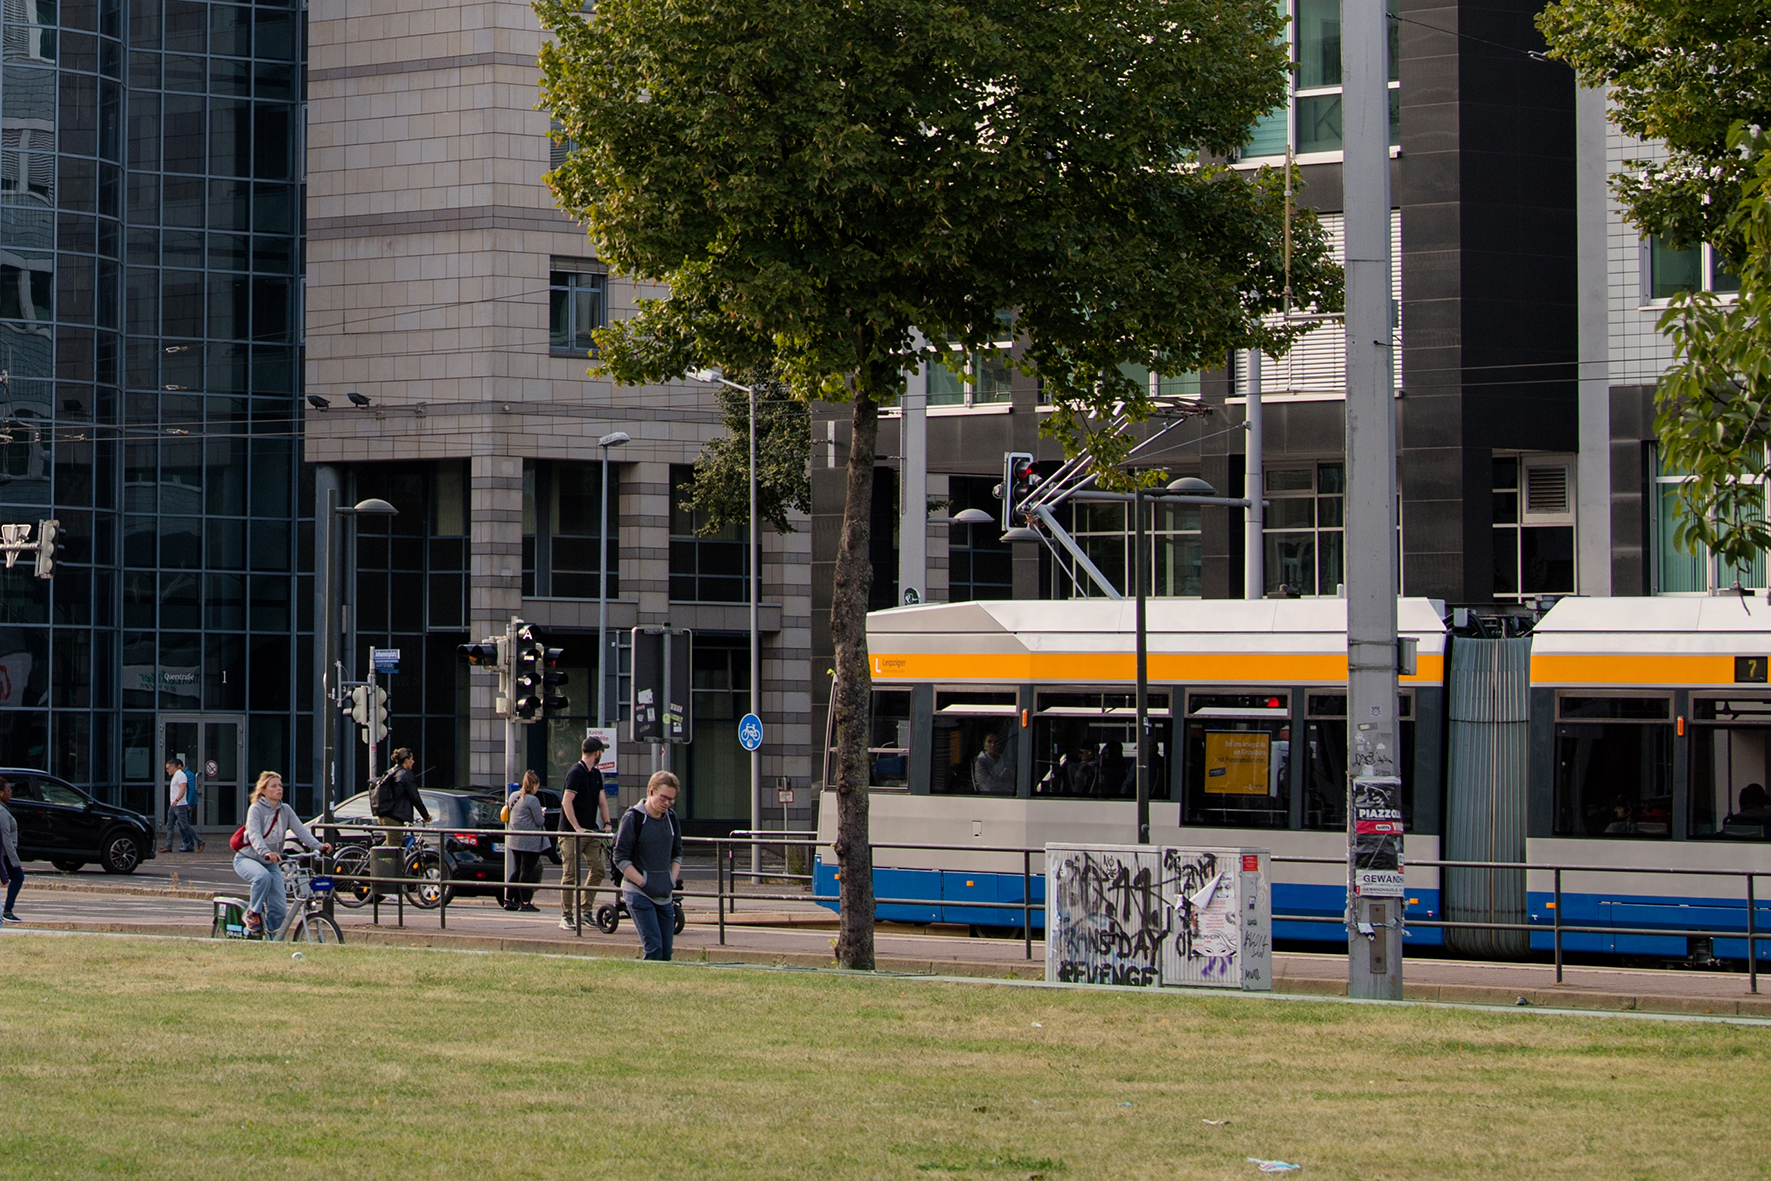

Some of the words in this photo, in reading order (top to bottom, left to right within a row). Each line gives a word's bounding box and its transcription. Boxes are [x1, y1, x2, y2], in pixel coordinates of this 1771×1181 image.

[523, 628, 532, 640] A
[883, 658, 906, 668] Leipziger
[1748, 659, 1757, 677] 7
[164, 673, 195, 681] Querstraße
[222, 671, 227, 684] 1
[1058, 960, 1159, 986] REVENGE
